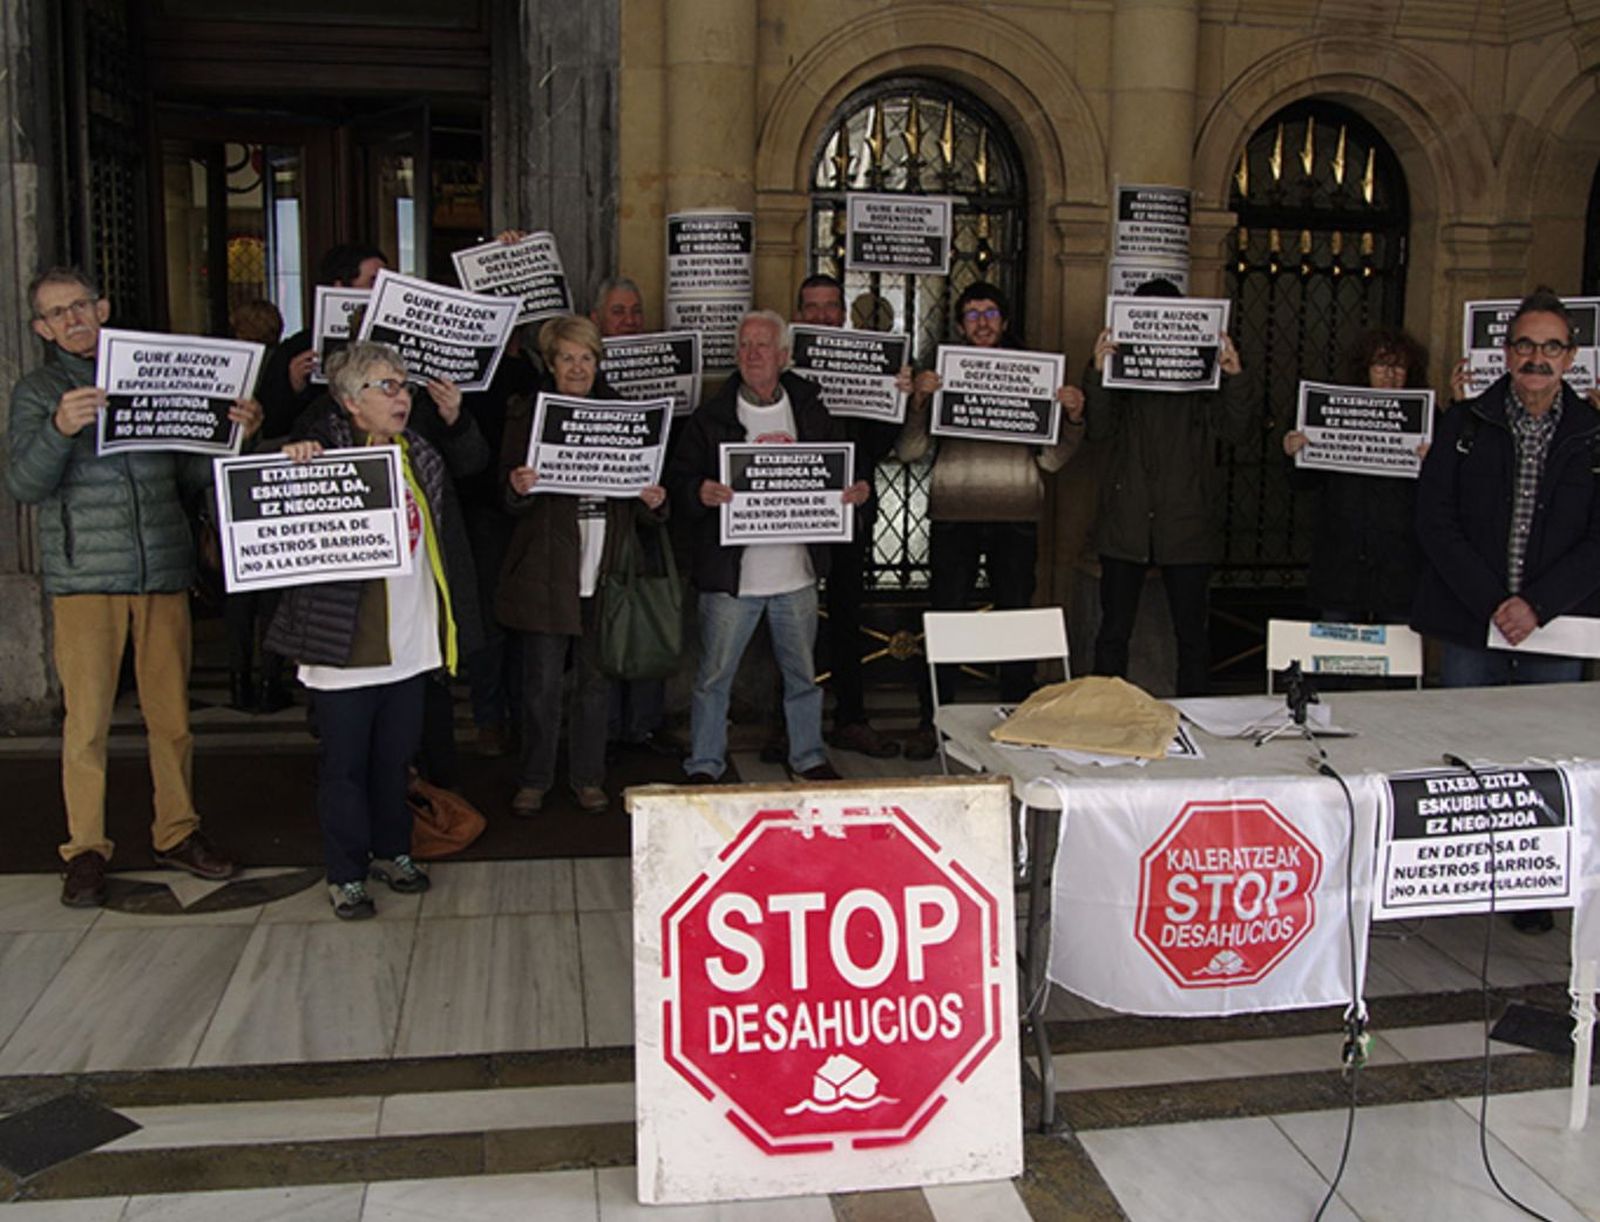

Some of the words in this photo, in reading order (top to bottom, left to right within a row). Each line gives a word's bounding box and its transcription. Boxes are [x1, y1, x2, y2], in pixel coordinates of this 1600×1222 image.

[403, 293, 440, 309] GURE
[445, 304, 497, 320] AUZOEN
[1128, 309, 1158, 318] GURE
[1163, 310, 1209, 321] AUZOEN
[400, 335, 415, 347] LA
[403, 347, 420, 359] UN
[1133, 346, 1147, 355] LA
[133, 350, 171, 363] GURE
[175, 353, 230, 367] AUZOEN
[811, 359, 825, 368] EZ
[1123, 356, 1136, 365] ES
[1138, 357, 1152, 366] UN
[960, 360, 990, 369] GURE
[994, 362, 1040, 374] AUZOEN
[1124, 368, 1140, 376] NO
[1142, 369, 1157, 377] UN
[138, 366, 219, 382] DEFENTSAN,
[118, 380, 213, 392] ESPEKULAZIOARI
[132, 397, 148, 407] LA
[152, 398, 209, 409] VIVIENDA
[964, 394, 978, 404] LA
[952, 404, 966, 414] ES
[968, 406, 983, 416] UN
[115, 410, 132, 422] ES
[135, 411, 153, 422] UN
[156, 411, 219, 426] DERECHO,
[953, 416, 969, 425] NO
[971, 418, 986, 426] UN
[1325, 418, 1340, 426] EZ
[115, 425, 133, 436] NO
[136, 425, 154, 435] UN
[156, 425, 214, 438] NEGOCIO
[562, 421, 629, 433] ESKUBIDEA
[565, 434, 582, 444] EZ
[1338, 433, 1386, 444] DEFENSA
[1389, 437, 1402, 445] DE
[558, 451, 573, 459] EN
[576, 451, 627, 460] DEFENSA
[628, 453, 642, 461] DE
[261, 463, 358, 482] ETXEBIZITZA
[541, 462, 599, 472] NUESTROS
[746, 467, 810, 478] ESKUBIDEA
[811, 467, 831, 478] DA,
[252, 481, 340, 500] ESKUBIDEA
[342, 479, 370, 494] DA,
[751, 480, 765, 490] EZ
[768, 480, 825, 489] NEGOZIOA
[261, 502, 281, 516] EZ
[284, 496, 364, 514] NEGOZIOA
[747, 498, 760, 506] EN
[763, 497, 810, 506] DEFENSA
[812, 496, 826, 505] DE
[733, 509, 787, 519] NUESTROS
[790, 509, 839, 518] BARRIOS,
[258, 525, 277, 538] EN
[281, 519, 346, 536] DEFENSA
[350, 517, 370, 530] DE
[241, 538, 318, 557] NUESTROS
[321, 534, 390, 548] BARRIOS,
[240, 561, 262, 574] ¡NO
[265, 560, 274, 570] A
[277, 558, 292, 569] LA
[295, 549, 393, 566] ESPECULACIÓN!
[1425, 773, 1530, 795] ETXEBZITZA
[1516, 791, 1544, 807] DA,
[1426, 818, 1448, 834] EZ
[1418, 846, 1439, 860] EN
[1444, 840, 1514, 857] DEFENSA
[1519, 837, 1540, 851] DE
[1166, 846, 1302, 871] KALERATZEAK
[1393, 862, 1480, 879] NUESTROS
[1165, 872, 1299, 923] STOP
[1391, 885, 1415, 900] ¡NO
[1419, 885, 1429, 895] A
[1432, 883, 1449, 894] LA
[1160, 915, 1295, 948] DESAHUCIOS
[705, 885, 960, 993] STOP
[708, 993, 964, 1055] DESAHUCIOS
